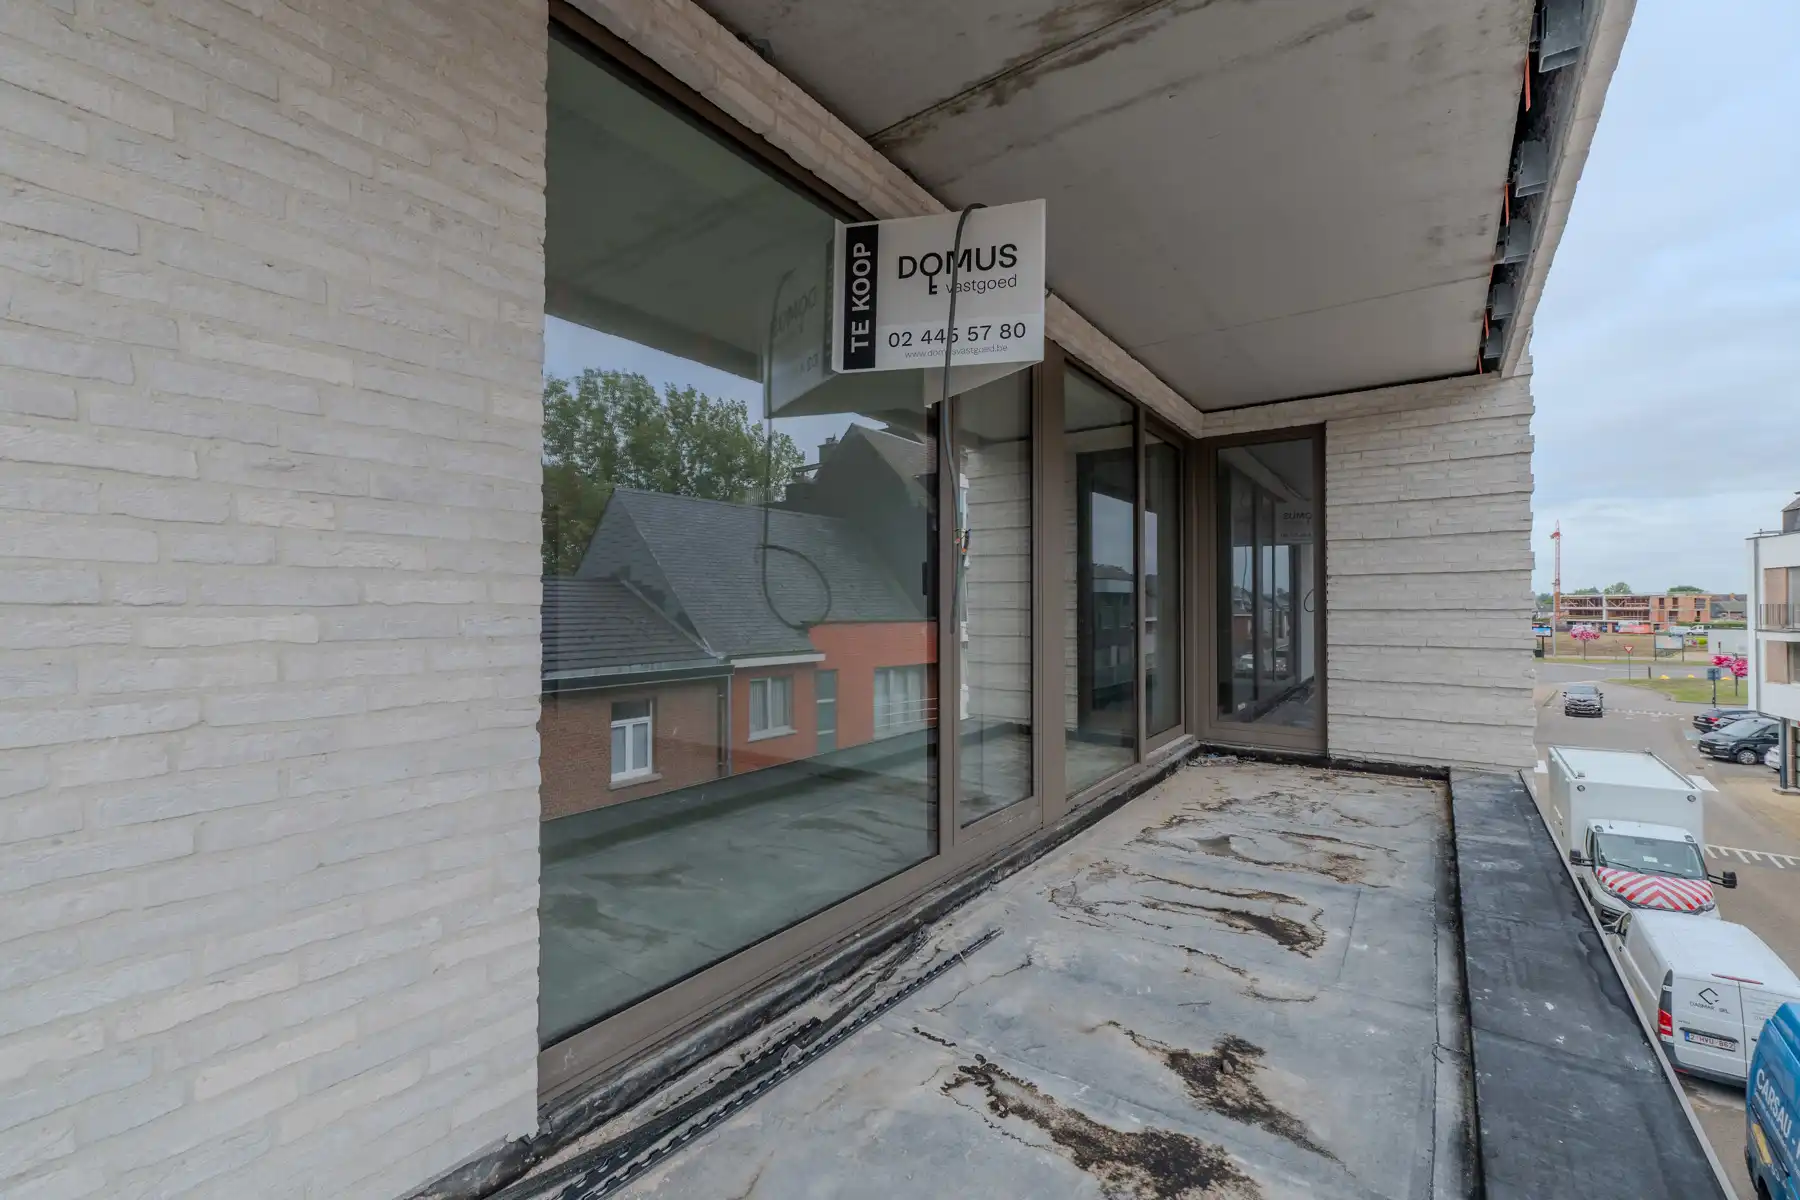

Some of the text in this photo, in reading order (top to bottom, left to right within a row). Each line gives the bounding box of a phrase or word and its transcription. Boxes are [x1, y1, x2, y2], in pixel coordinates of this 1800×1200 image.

[898, 243, 1018, 280] DOMUS
[851, 242, 871, 353] TE KOOP
[945, 274, 1017, 294] vastgoed
[888, 322, 1026, 348] 02 445 57 80
[904, 343, 1008, 359] www.domsvastgoed.be
[1756, 1068, 1792, 1139] CARSAU
